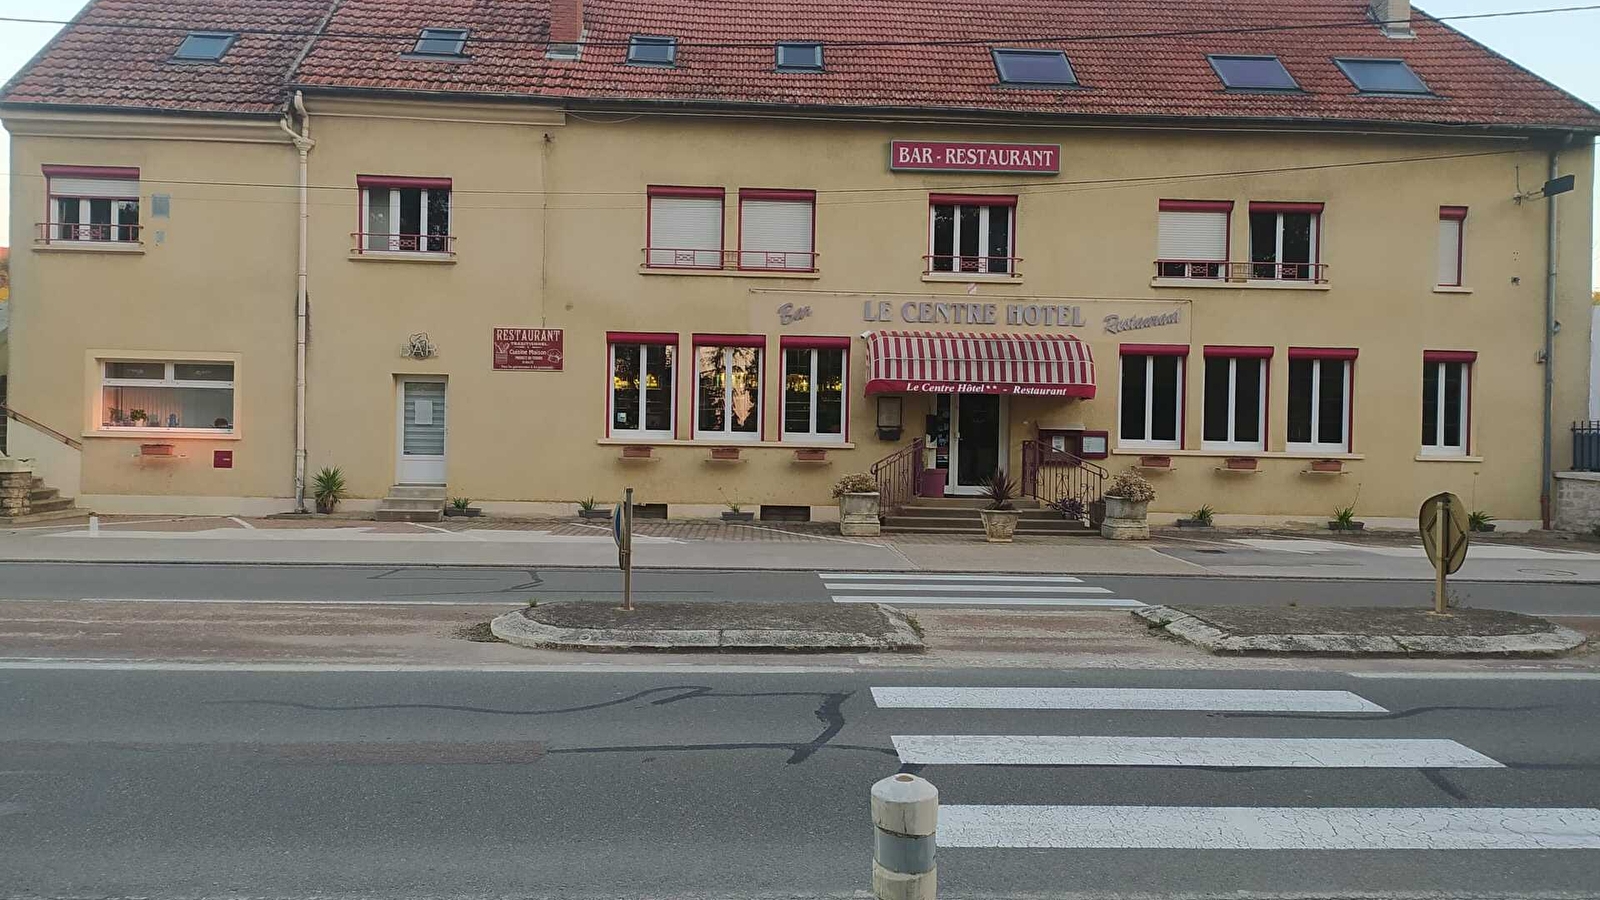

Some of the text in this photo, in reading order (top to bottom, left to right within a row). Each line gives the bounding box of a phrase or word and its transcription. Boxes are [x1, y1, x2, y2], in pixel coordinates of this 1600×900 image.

[899, 147, 934, 164] BAR
[945, 148, 1054, 167] RESTAURANT
[777, 302, 813, 325] Bar
[863, 301, 1087, 327] LE CENTRE HOTEL
[1102, 307, 1182, 335] Restaurant
[496, 329, 561, 342] RESTAURANT
[906, 383, 919, 392] Le
[921, 383, 955, 393] Centre
[1013, 385, 1067, 397] Restaurant
